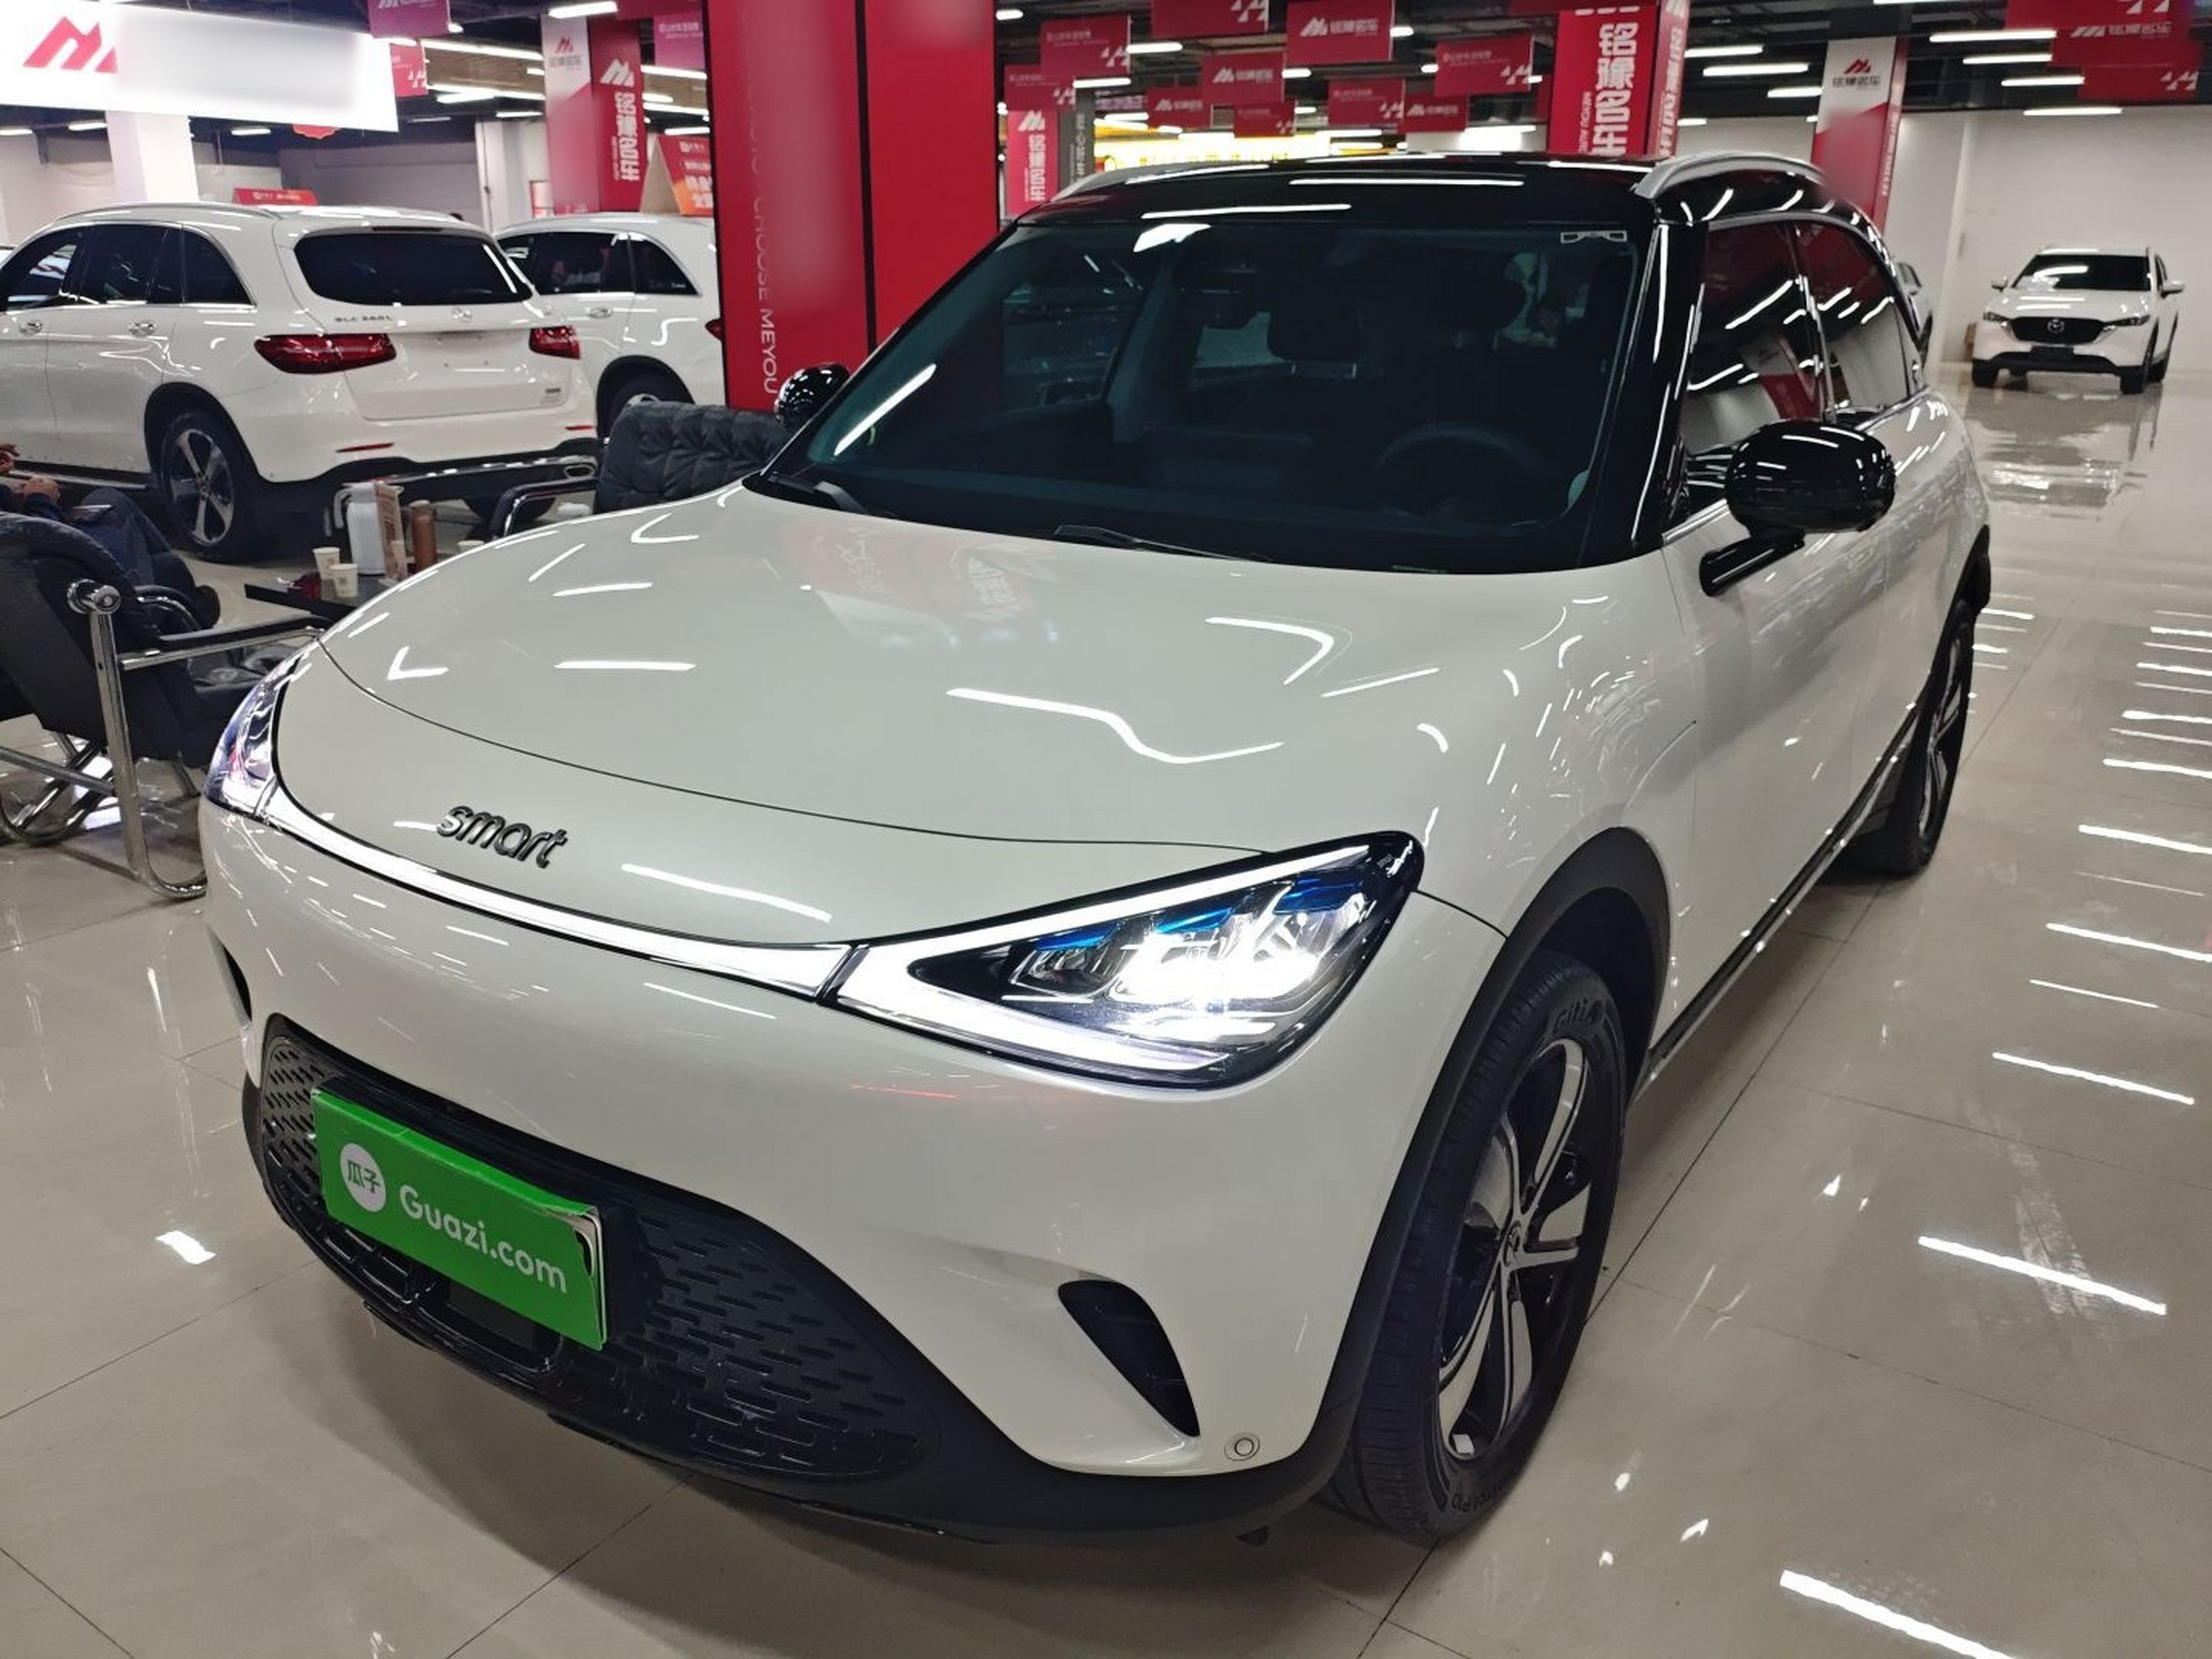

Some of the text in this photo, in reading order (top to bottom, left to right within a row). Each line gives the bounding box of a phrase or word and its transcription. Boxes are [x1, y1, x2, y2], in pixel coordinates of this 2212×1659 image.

[760, 308, 778, 395] MEYOU
[436, 805, 568, 869] smart
[346, 1158, 382, 1195] 瓜子
[399, 1185, 567, 1293] Guazi.com
